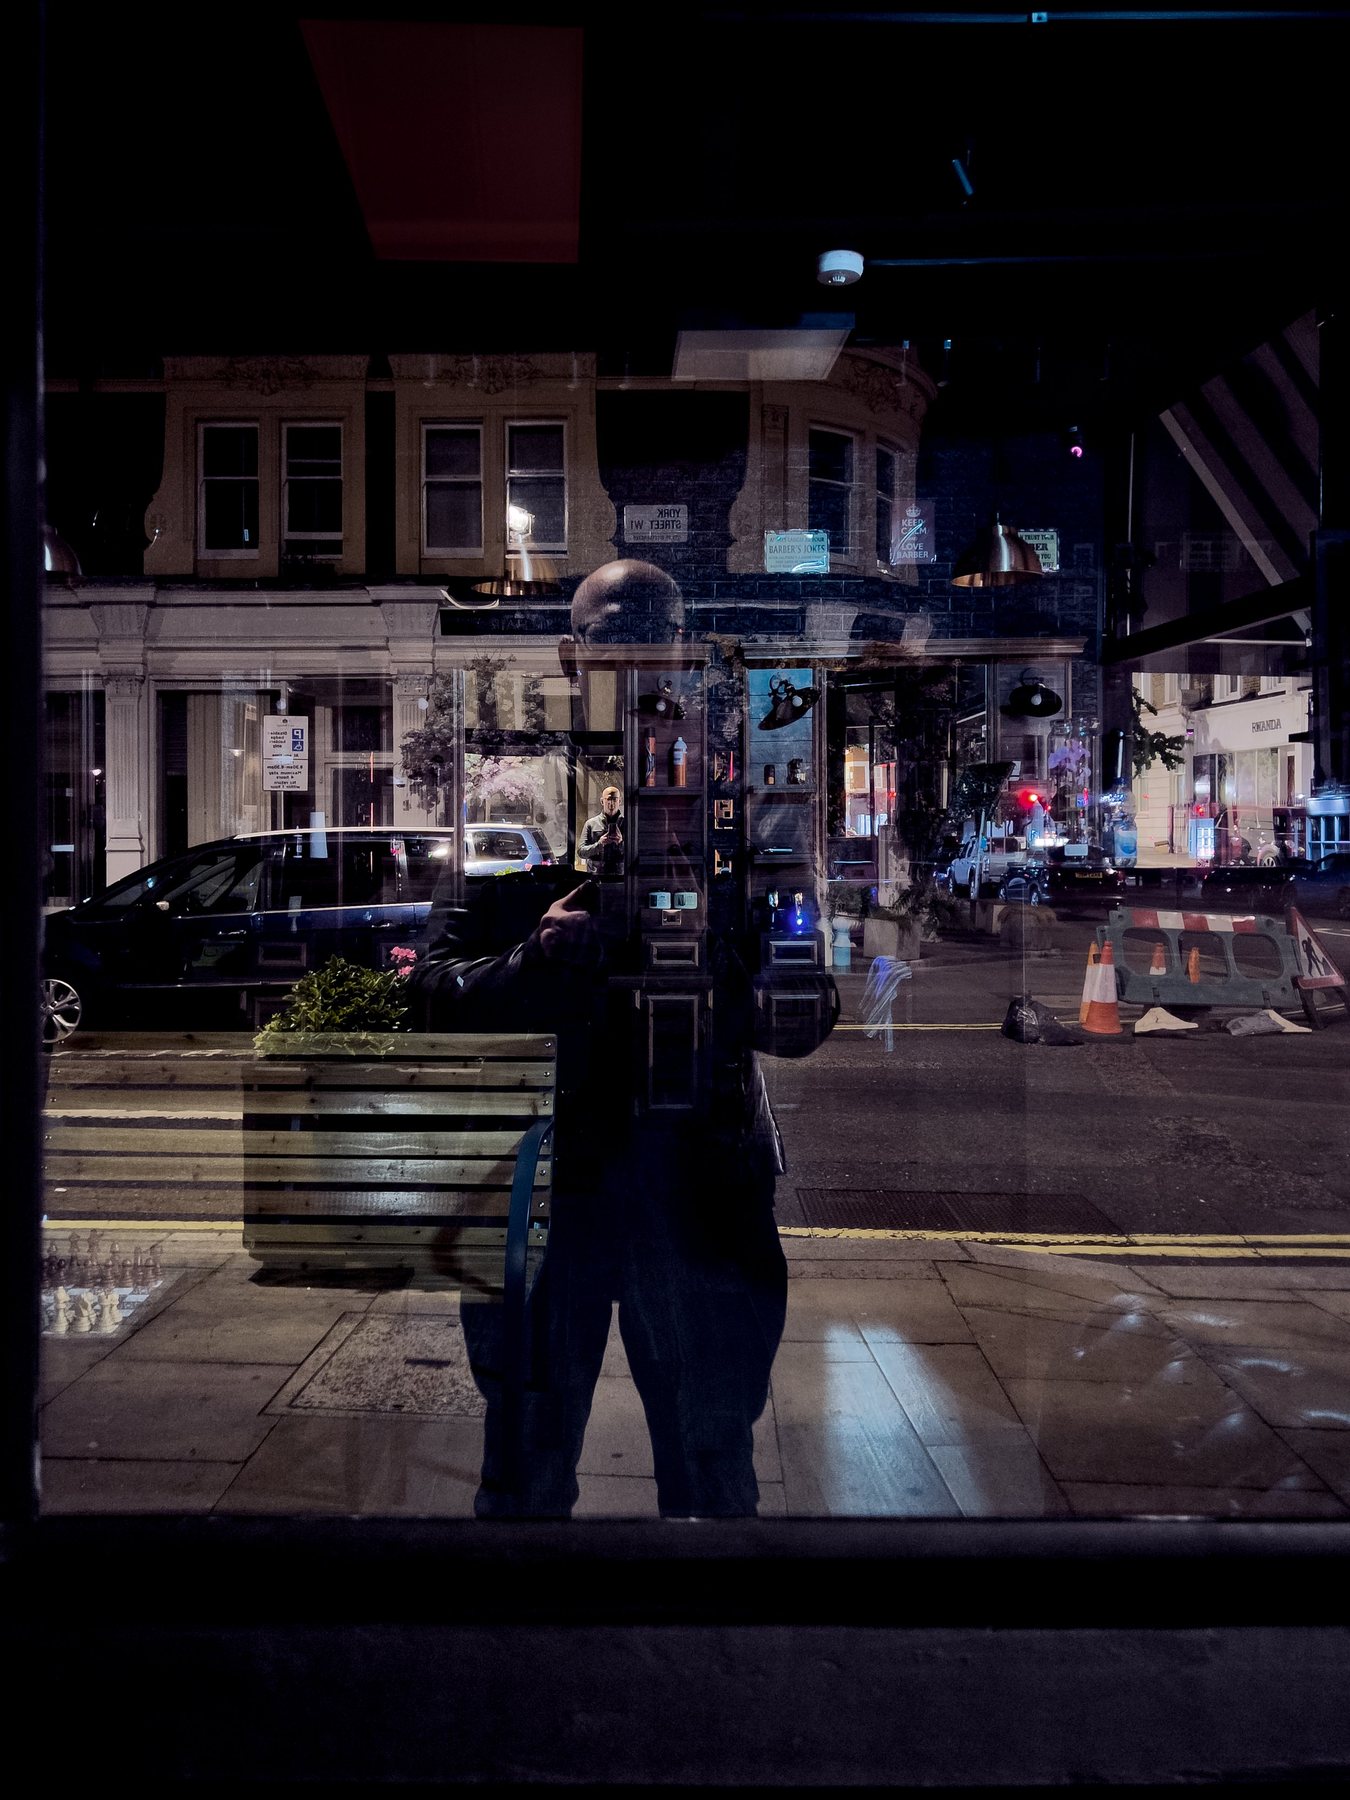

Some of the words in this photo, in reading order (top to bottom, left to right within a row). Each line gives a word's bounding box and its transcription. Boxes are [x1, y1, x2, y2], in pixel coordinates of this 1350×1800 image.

[769, 544, 802, 554] BARBER'S
[803, 544, 826, 554] JOKES
[902, 542, 924, 551] LOVE
[897, 550, 929, 559] BARBER
[1251, 718, 1282, 733] RWANDA
